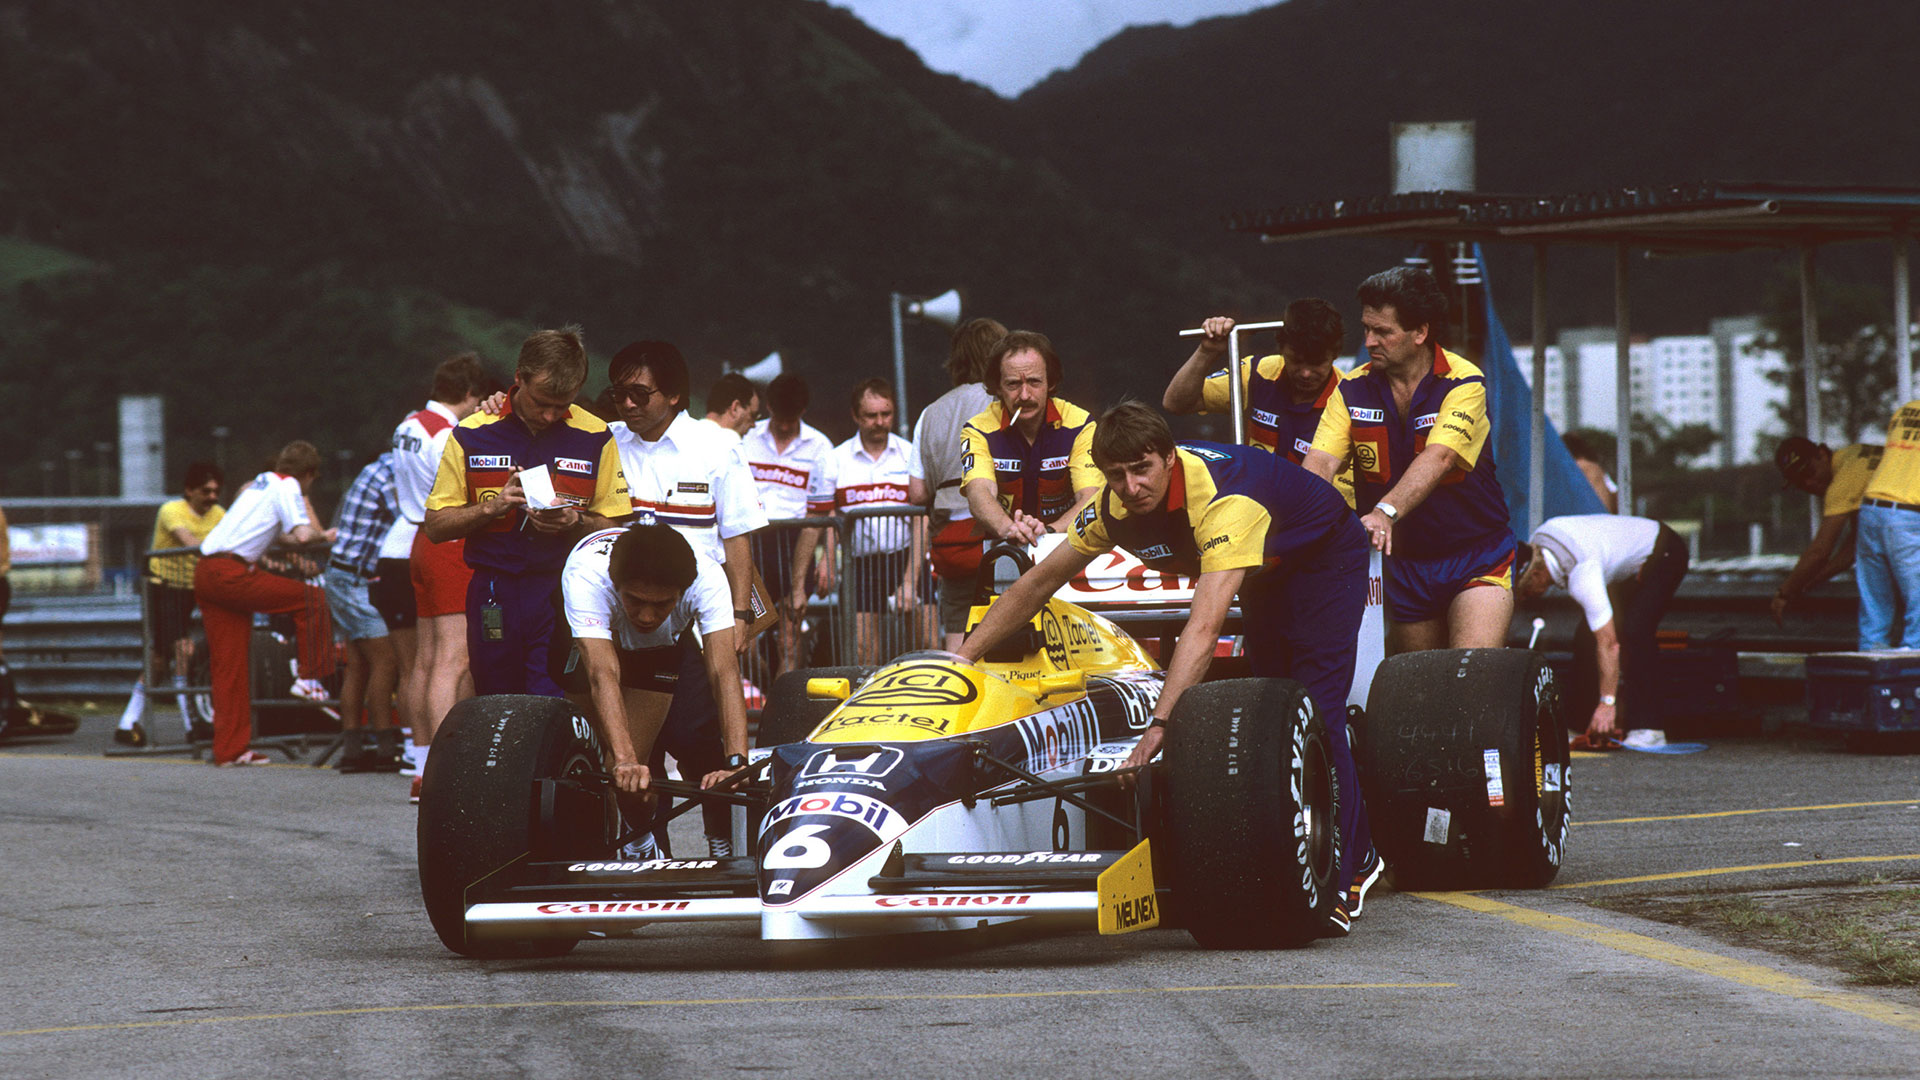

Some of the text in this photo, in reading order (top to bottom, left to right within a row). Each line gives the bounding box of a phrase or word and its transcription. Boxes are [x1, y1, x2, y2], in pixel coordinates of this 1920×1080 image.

[470, 457, 497, 467] Mobil
[556, 459, 591, 472] Canon
[993, 461, 1009, 470] obil
[1041, 459, 1069, 470] Cano
[845, 485, 907, 503] Beatrice
[1202, 534, 1230, 551] calma
[1044, 620, 1058, 643] ICI
[1063, 615, 1102, 646] Tactel
[882, 675, 951, 689] ICI
[1009, 670, 1041, 684] Piquet
[1019, 704, 1081, 773] Mobil
[796, 777, 887, 792] HONDA
[764, 795, 889, 832] Mobil
[1052, 796, 1070, 852] 6
[762, 824, 832, 870] 6
[567, 858, 718, 873] GOODYEAR
[947, 851, 1102, 866] GOODYEAR
[536, 901, 691, 914] Canon
[874, 895, 1031, 907] Canon
[1116, 893, 1156, 931] MELINEX
